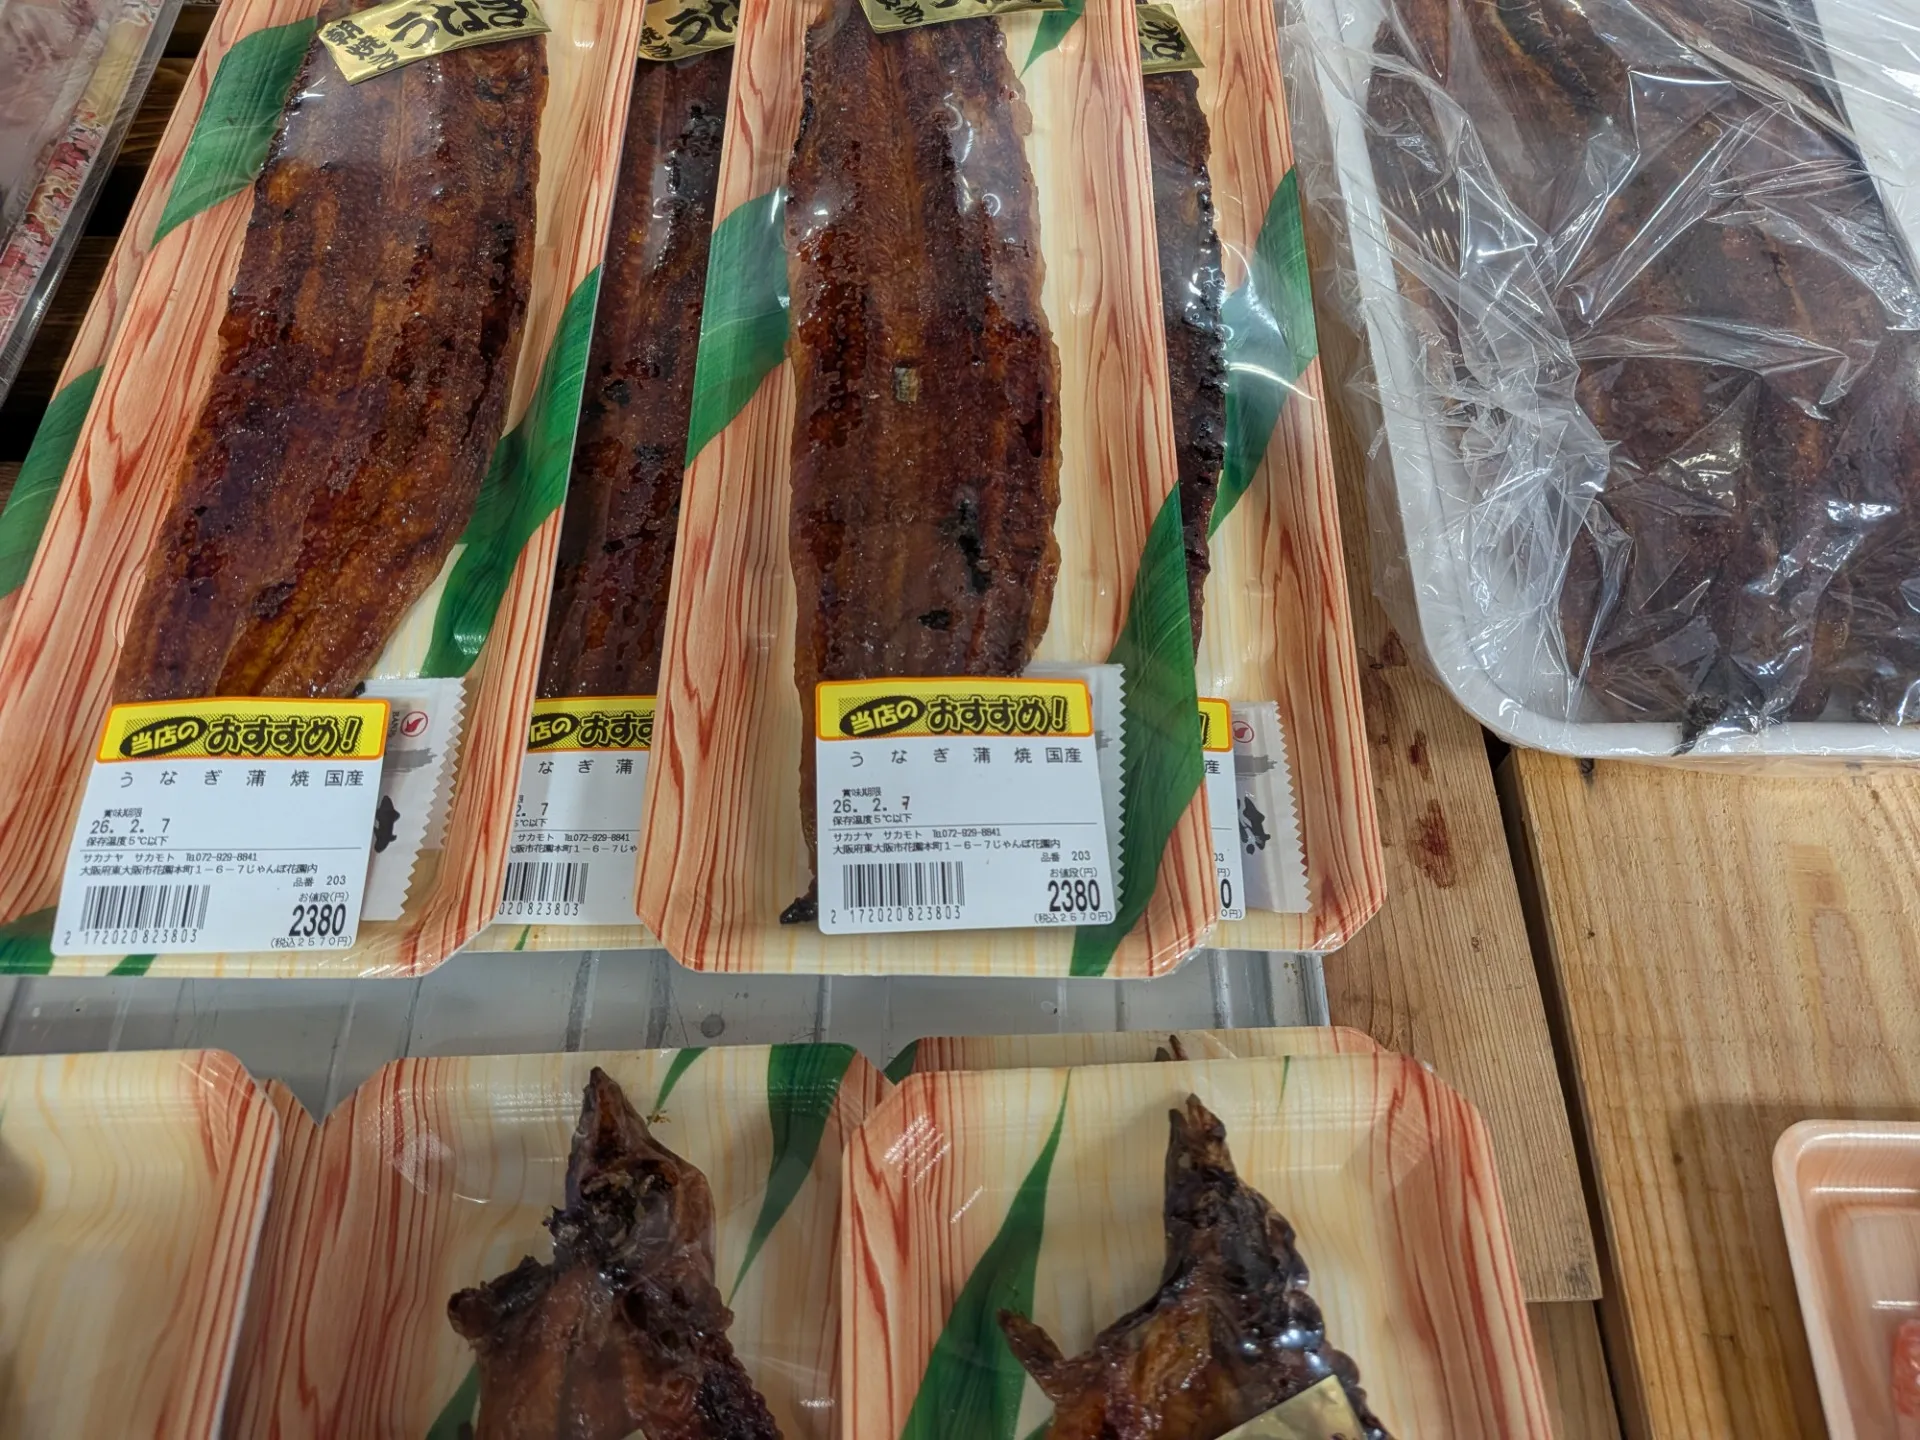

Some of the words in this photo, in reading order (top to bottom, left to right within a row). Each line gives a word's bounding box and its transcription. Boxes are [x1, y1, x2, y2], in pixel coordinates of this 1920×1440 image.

[1041, 852, 1060, 862] 品番
[1071, 850, 1091, 861] 203
[293, 877, 314, 887] 品番
[326, 875, 346, 886] 203
[1047, 878, 1101, 913] 2380
[288, 903, 347, 938] 2380
